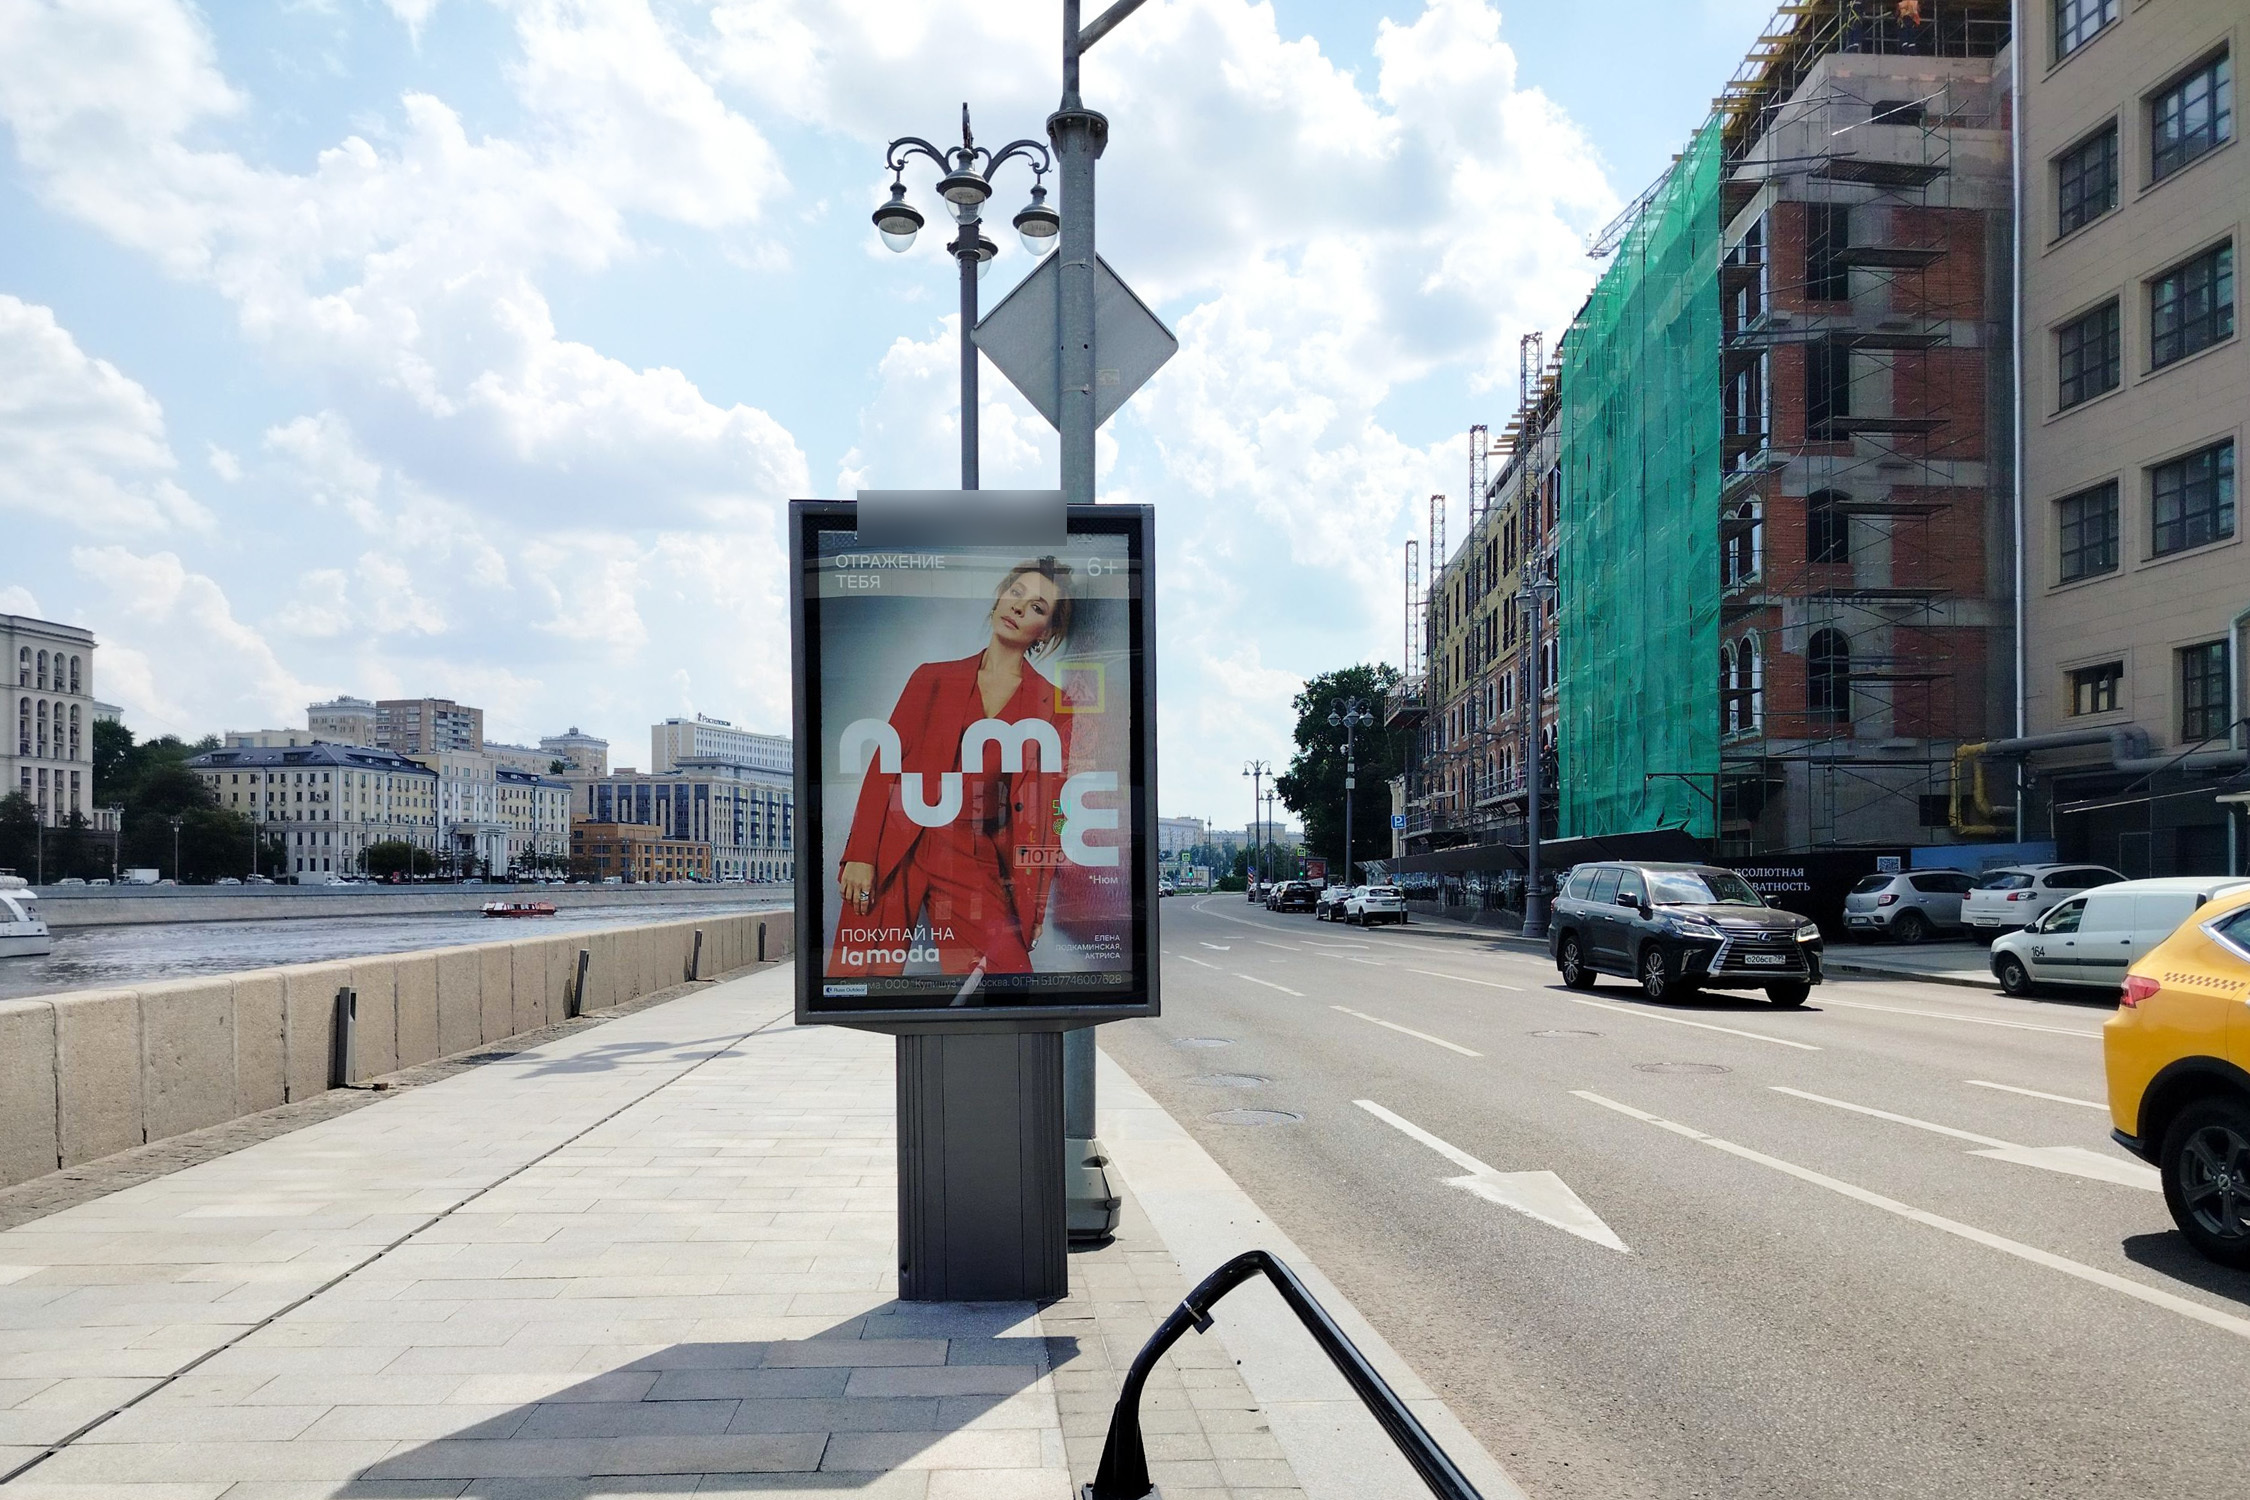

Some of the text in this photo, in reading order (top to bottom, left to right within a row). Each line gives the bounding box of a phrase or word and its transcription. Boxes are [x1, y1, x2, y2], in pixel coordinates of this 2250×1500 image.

[835, 554, 945, 569] ОТРАЖЕНИЕ
[1087, 556, 1118, 577] 6+
[835, 574, 881, 589] ТЕБЯ
[1732, 867, 1804, 877] БСОЛЮТНАЯ
[1750, 882, 1811, 892] ВАТНОСТЬ
[841, 924, 955, 942] ПОКУПАЙ НА
[1094, 934, 1121, 942] ЕЛЕНА
[841, 944, 940, 966] lamoda
[1084, 952, 1121, 960] АКТРИСА
[2031, 945, 2046, 957] 164
[1012, 975, 1040, 987] ОГРН
[1041, 973, 1122, 986] 5107746007628
